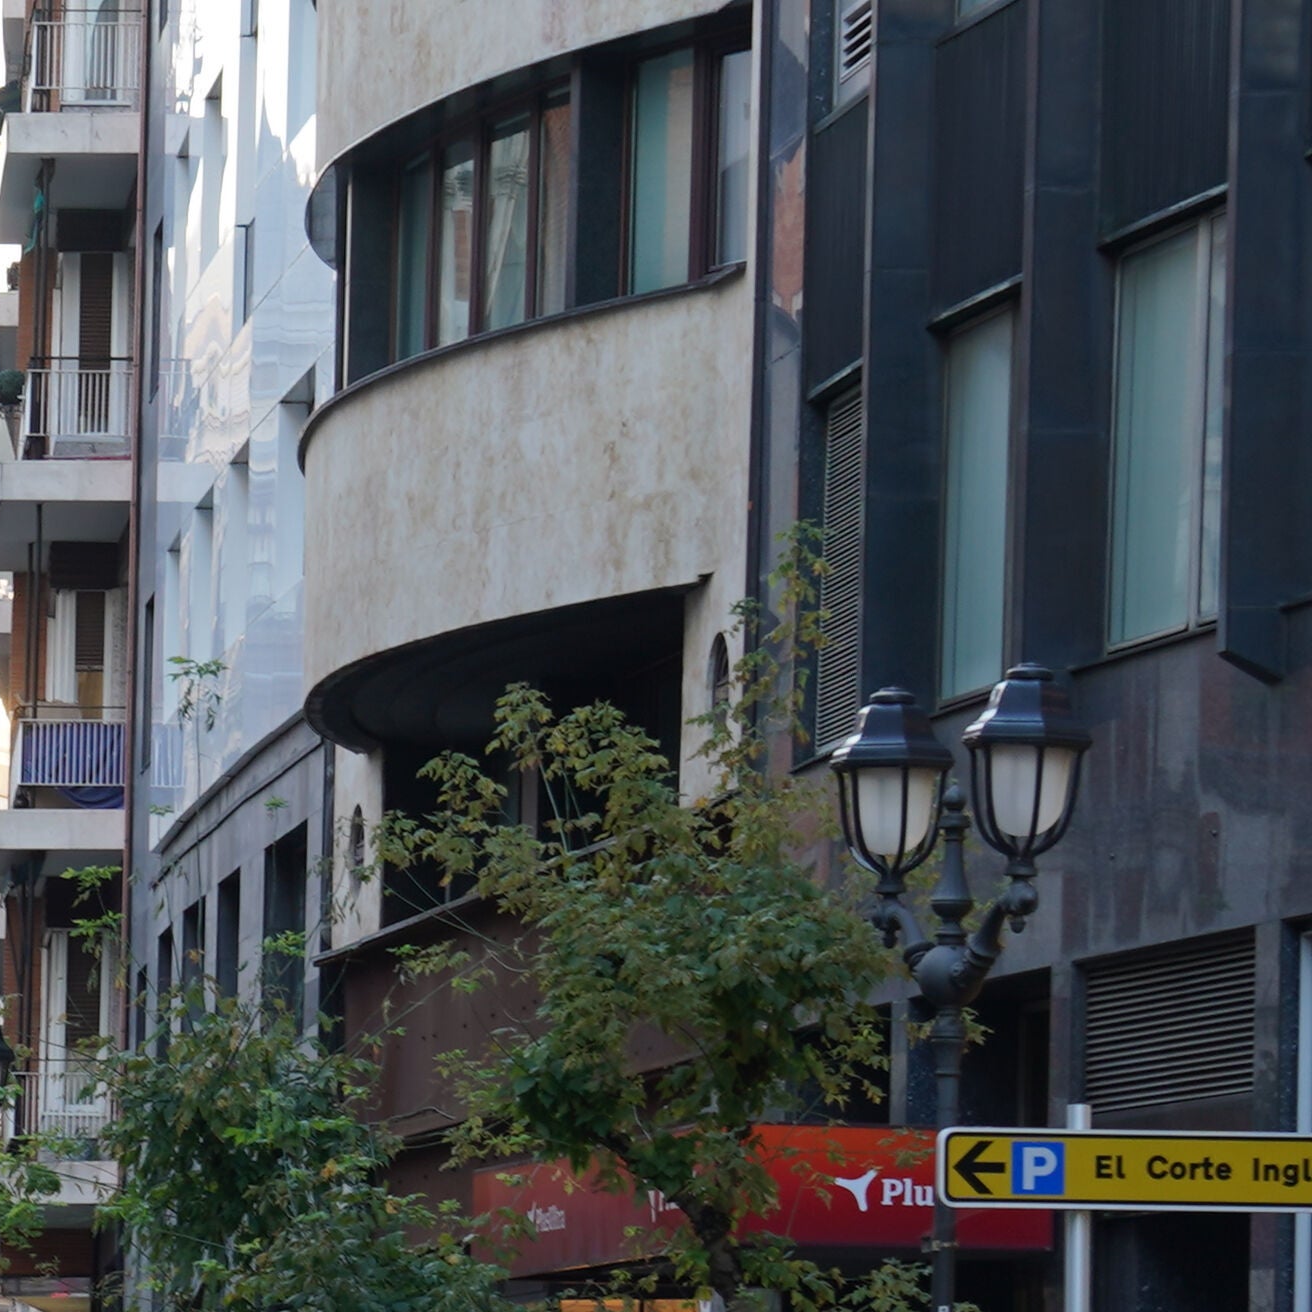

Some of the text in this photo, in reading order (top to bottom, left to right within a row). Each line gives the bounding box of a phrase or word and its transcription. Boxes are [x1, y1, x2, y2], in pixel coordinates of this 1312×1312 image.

[1095, 1155, 1125, 1180] El
[1146, 1155, 1232, 1181] Corte
[1252, 1157, 1312, 1187] Ingl
[881, 1178, 934, 1206] Plu
